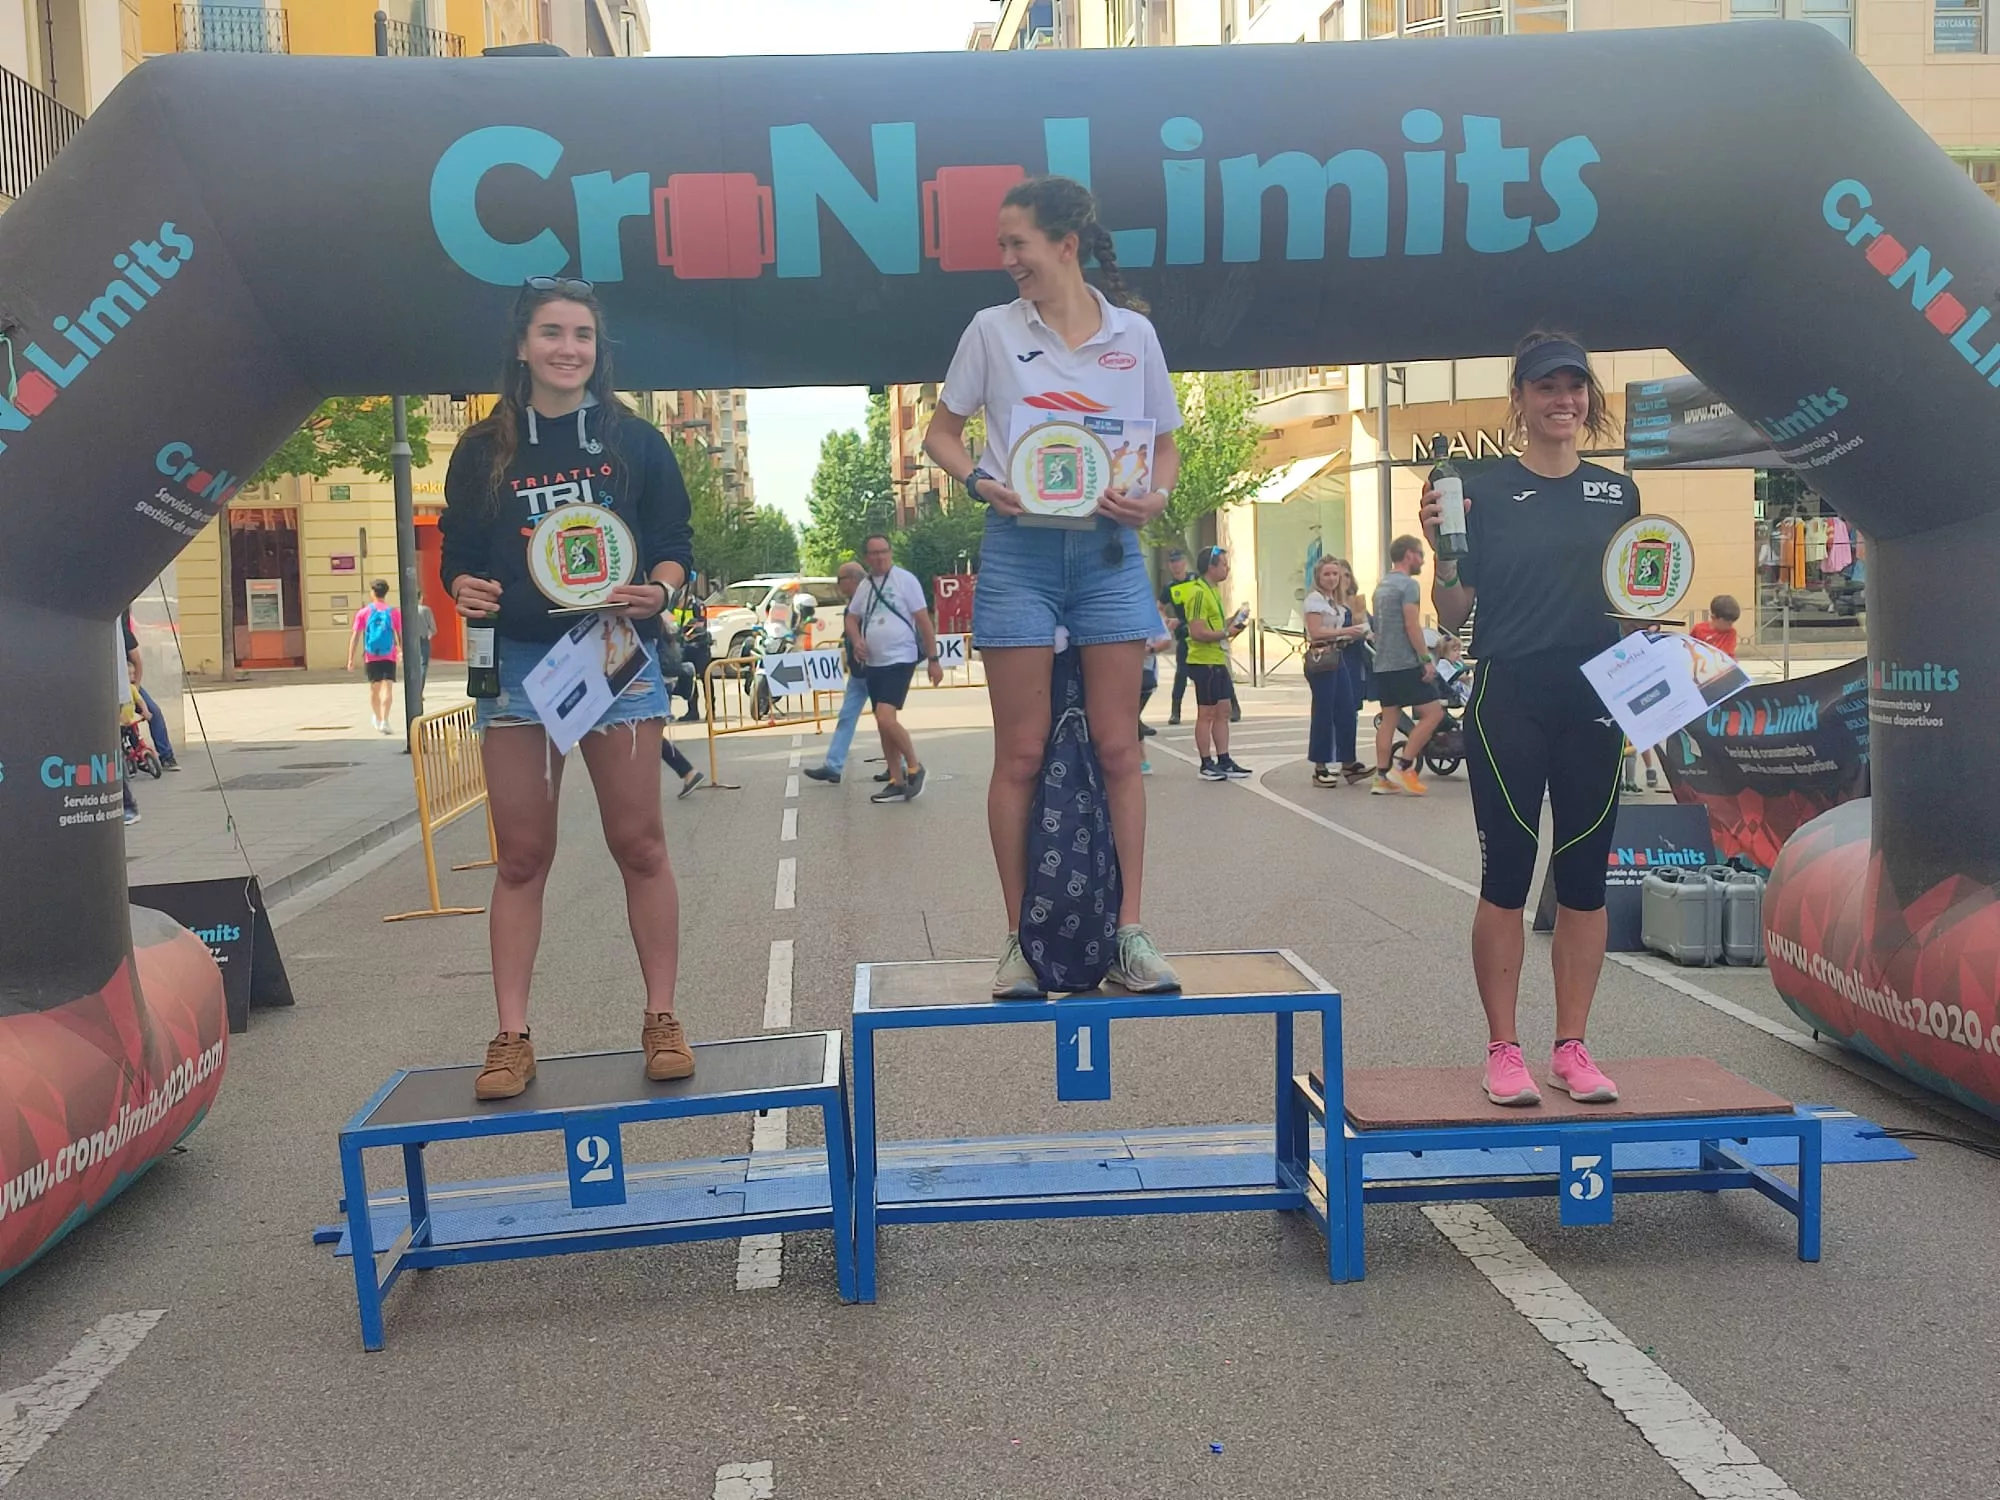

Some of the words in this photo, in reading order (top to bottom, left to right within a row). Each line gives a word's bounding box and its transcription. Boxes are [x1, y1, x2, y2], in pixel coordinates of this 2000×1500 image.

[516, 479, 594, 515] TRI
[1582, 480, 1624, 499] DYS
[808, 656, 843, 680] 10K
[63, 795, 99, 808] Servicio
[59, 810, 95, 827] gestión
[1069, 1025, 1094, 1072] 1
[576, 1135, 614, 1183] 2
[1569, 1155, 1604, 1200] 3
